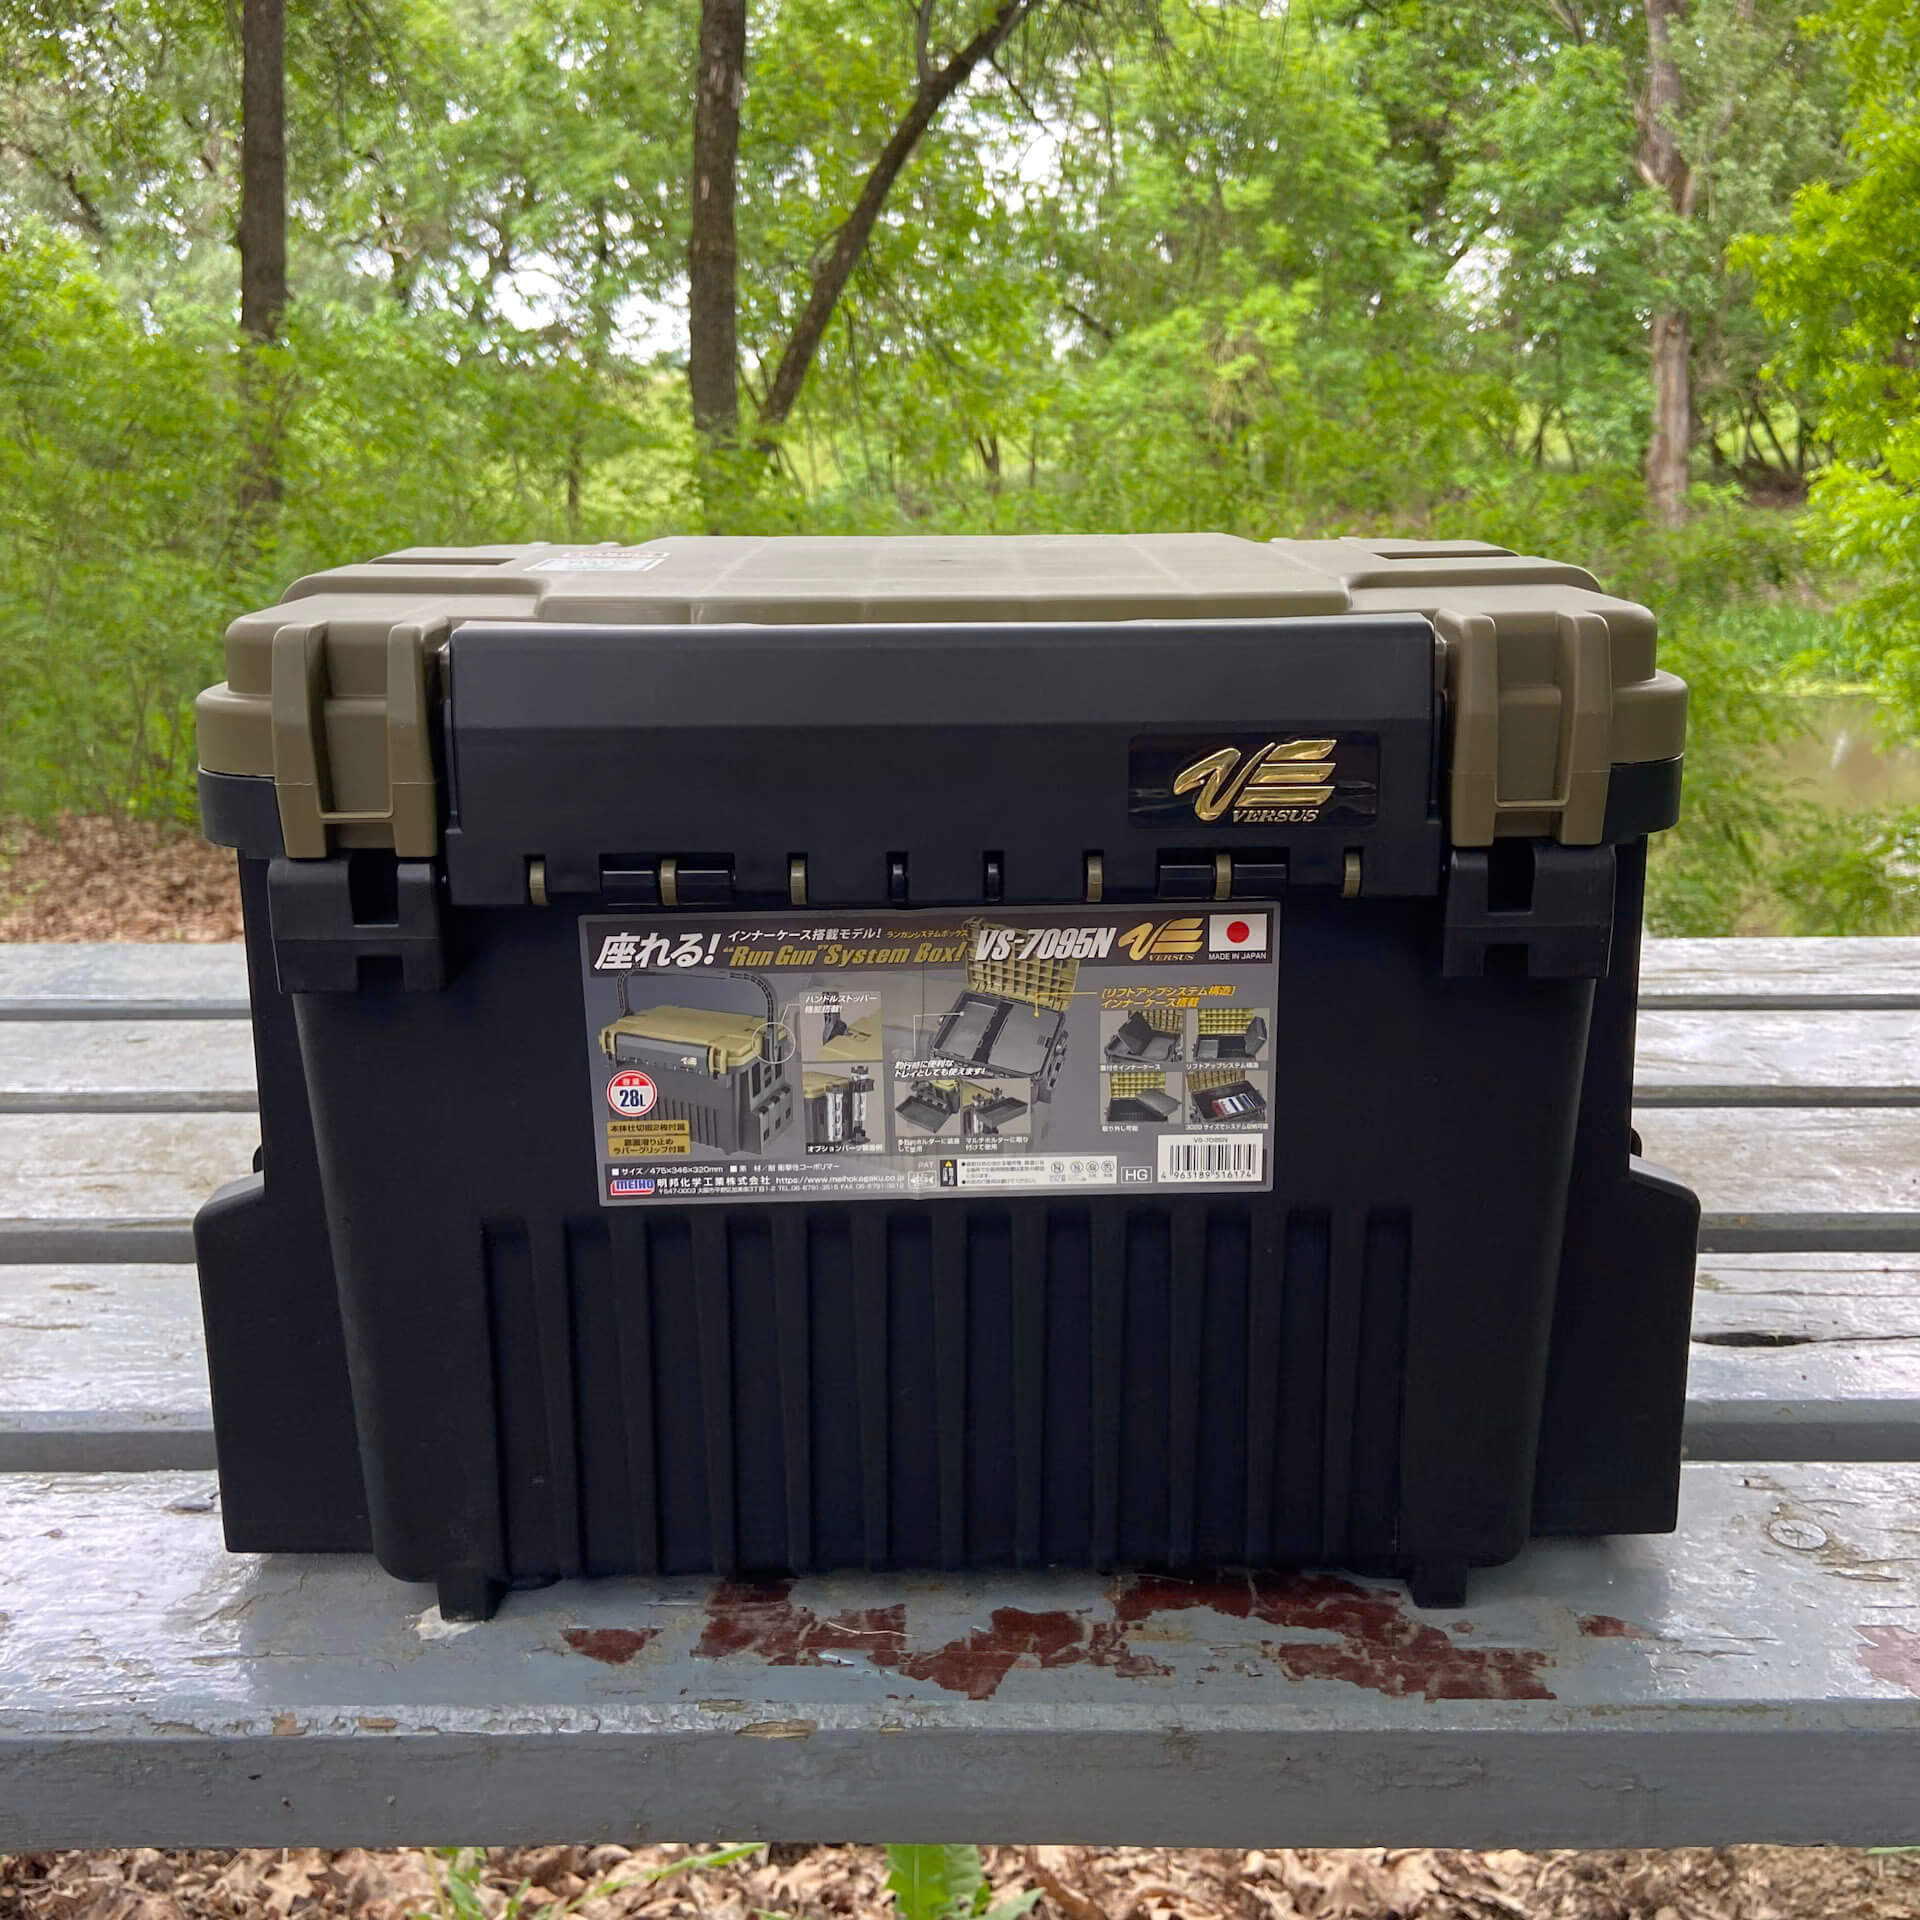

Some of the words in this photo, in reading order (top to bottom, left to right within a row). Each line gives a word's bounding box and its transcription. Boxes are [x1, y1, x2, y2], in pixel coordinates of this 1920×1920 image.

[1232, 809, 1320, 823] VERSUS
[975, 926, 1118, 962] VS-7095N
[913, 941, 969, 964] Box!
[1208, 952, 1230, 961] MADE
[1231, 952, 1240, 960] IN
[1240, 951, 1267, 960] JAPAN
[1125, 1168, 1148, 1181] HG
